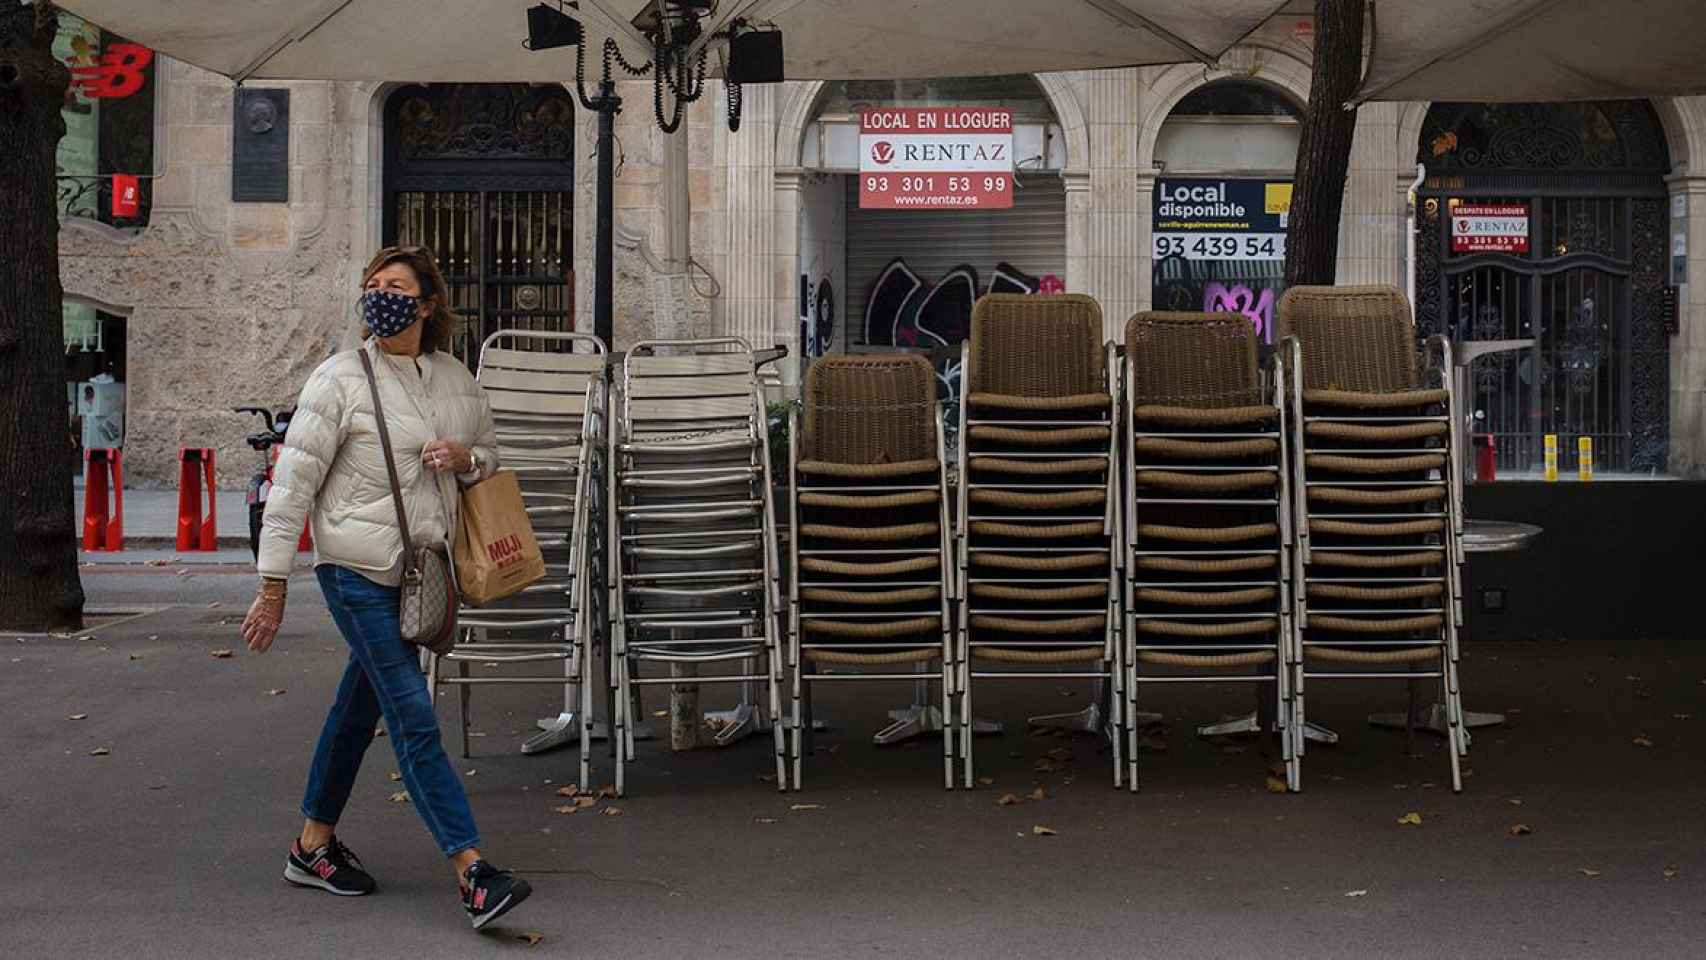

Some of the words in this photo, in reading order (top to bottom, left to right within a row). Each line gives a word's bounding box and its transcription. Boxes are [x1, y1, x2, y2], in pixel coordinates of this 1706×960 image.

[863, 112, 910, 129] LOCAL
[917, 112, 936, 129] EN
[944, 112, 1010, 129] LLOGUER
[905, 143, 1005, 161] RENTAZ
[867, 177, 888, 192] 93
[902, 177, 934, 192] 301
[949, 177, 971, 192] 53
[984, 177, 1006, 192] 99
[1159, 182, 1226, 202] Local
[894, 195, 978, 205] www.rentaz.es
[1158, 203, 1246, 218] disponible
[1475, 221, 1527, 232] RENTAZ
[1156, 236, 1185, 256] 93
[1192, 236, 1239, 256] 439
[1245, 236, 1276, 256] 54
[487, 533, 523, 561] MUJI
